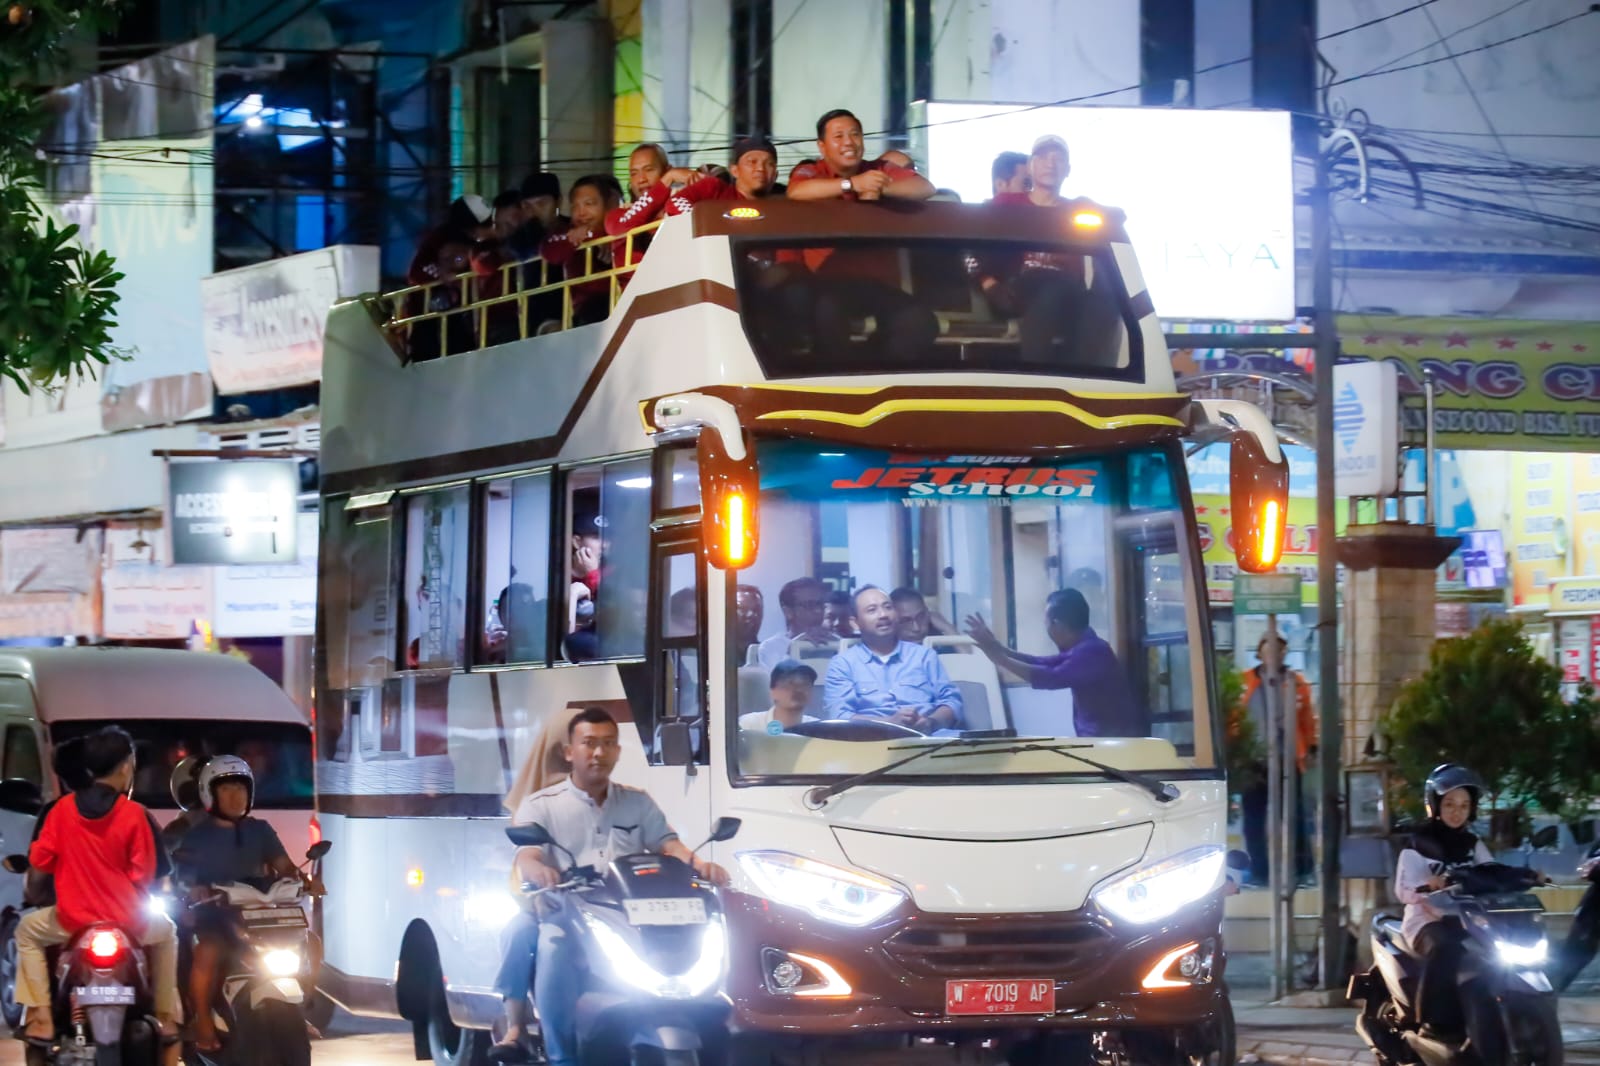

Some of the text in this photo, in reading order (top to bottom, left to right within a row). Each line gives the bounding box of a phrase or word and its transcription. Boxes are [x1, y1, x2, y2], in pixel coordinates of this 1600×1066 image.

[1433, 409, 1518, 435] SECOND
[1523, 411, 1570, 437] BISA
[1573, 413, 1600, 437] TU
[908, 482, 1096, 497] School
[954, 983, 1048, 1002] W 7019 AP
